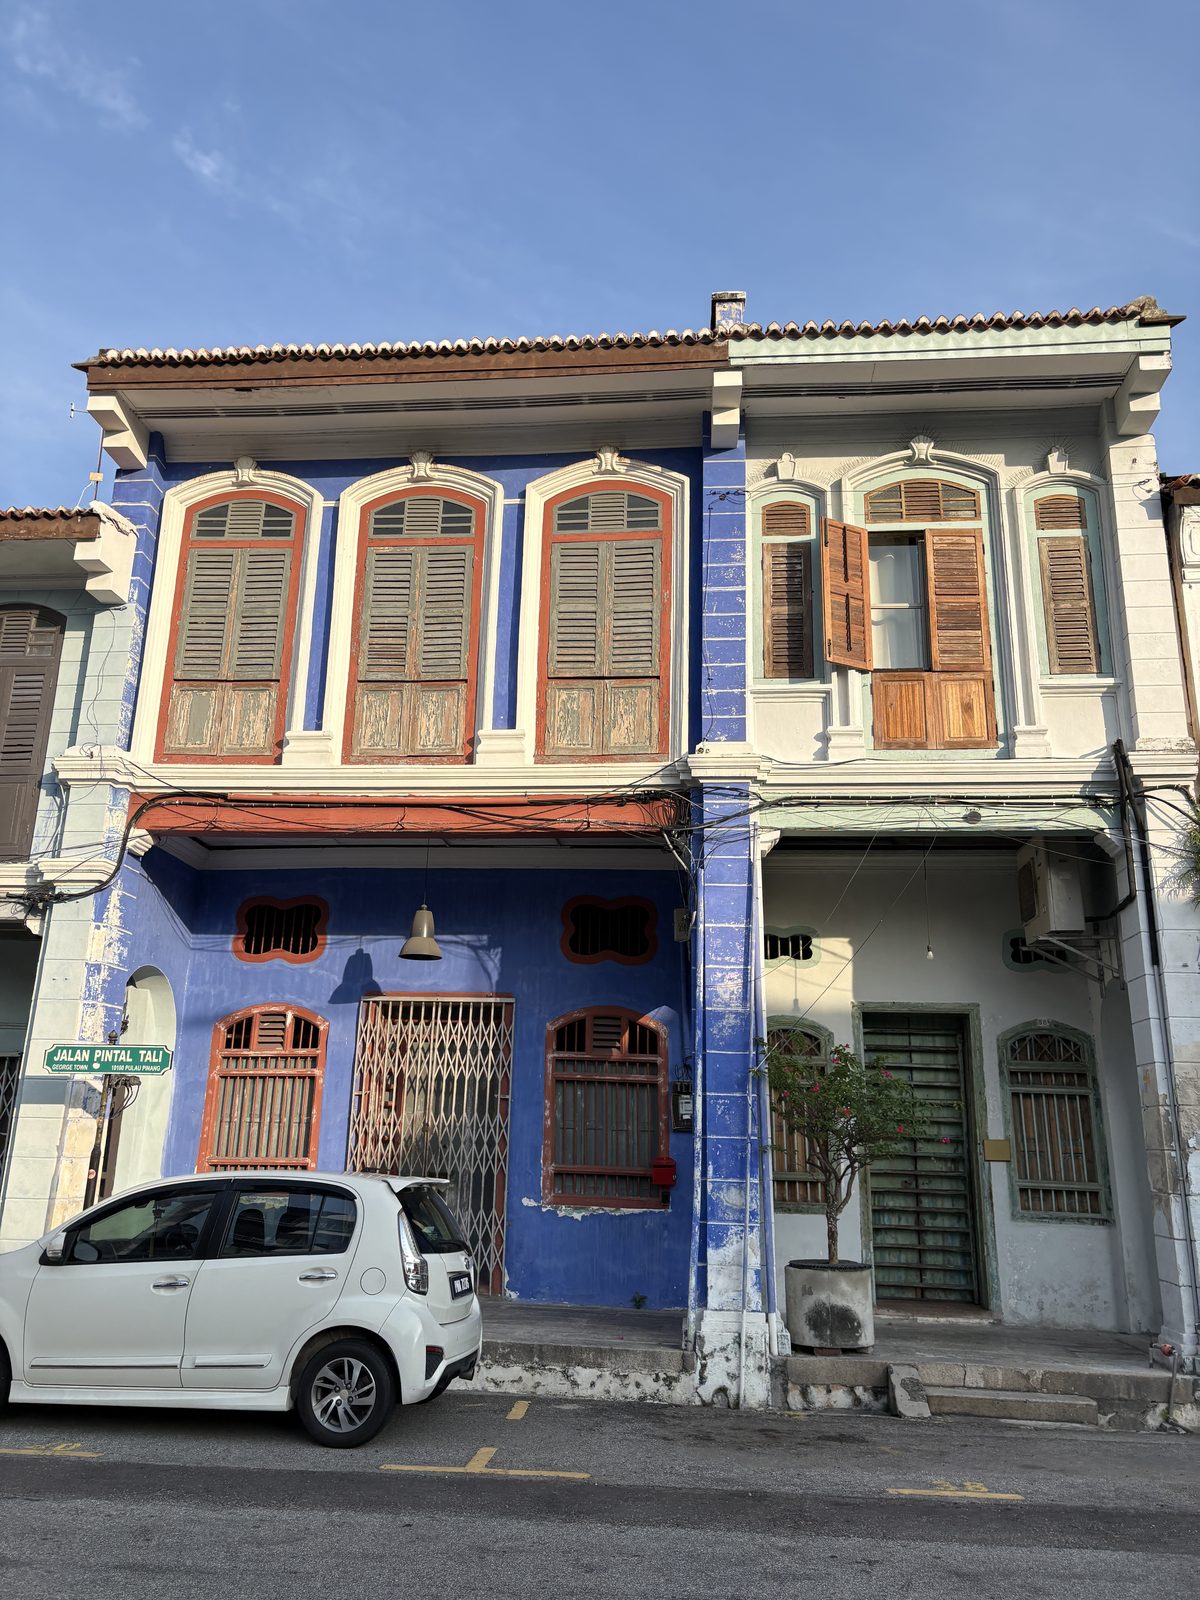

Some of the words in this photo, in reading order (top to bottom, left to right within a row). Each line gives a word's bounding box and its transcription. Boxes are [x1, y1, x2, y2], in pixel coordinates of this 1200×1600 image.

[53, 1049, 90, 1062] JALAN
[94, 1049, 133, 1062] PINTAL
[138, 1050, 163, 1063] TALI
[51, 1063, 73, 1071] GEORGE
[125, 1064, 142, 1072] PULAU
